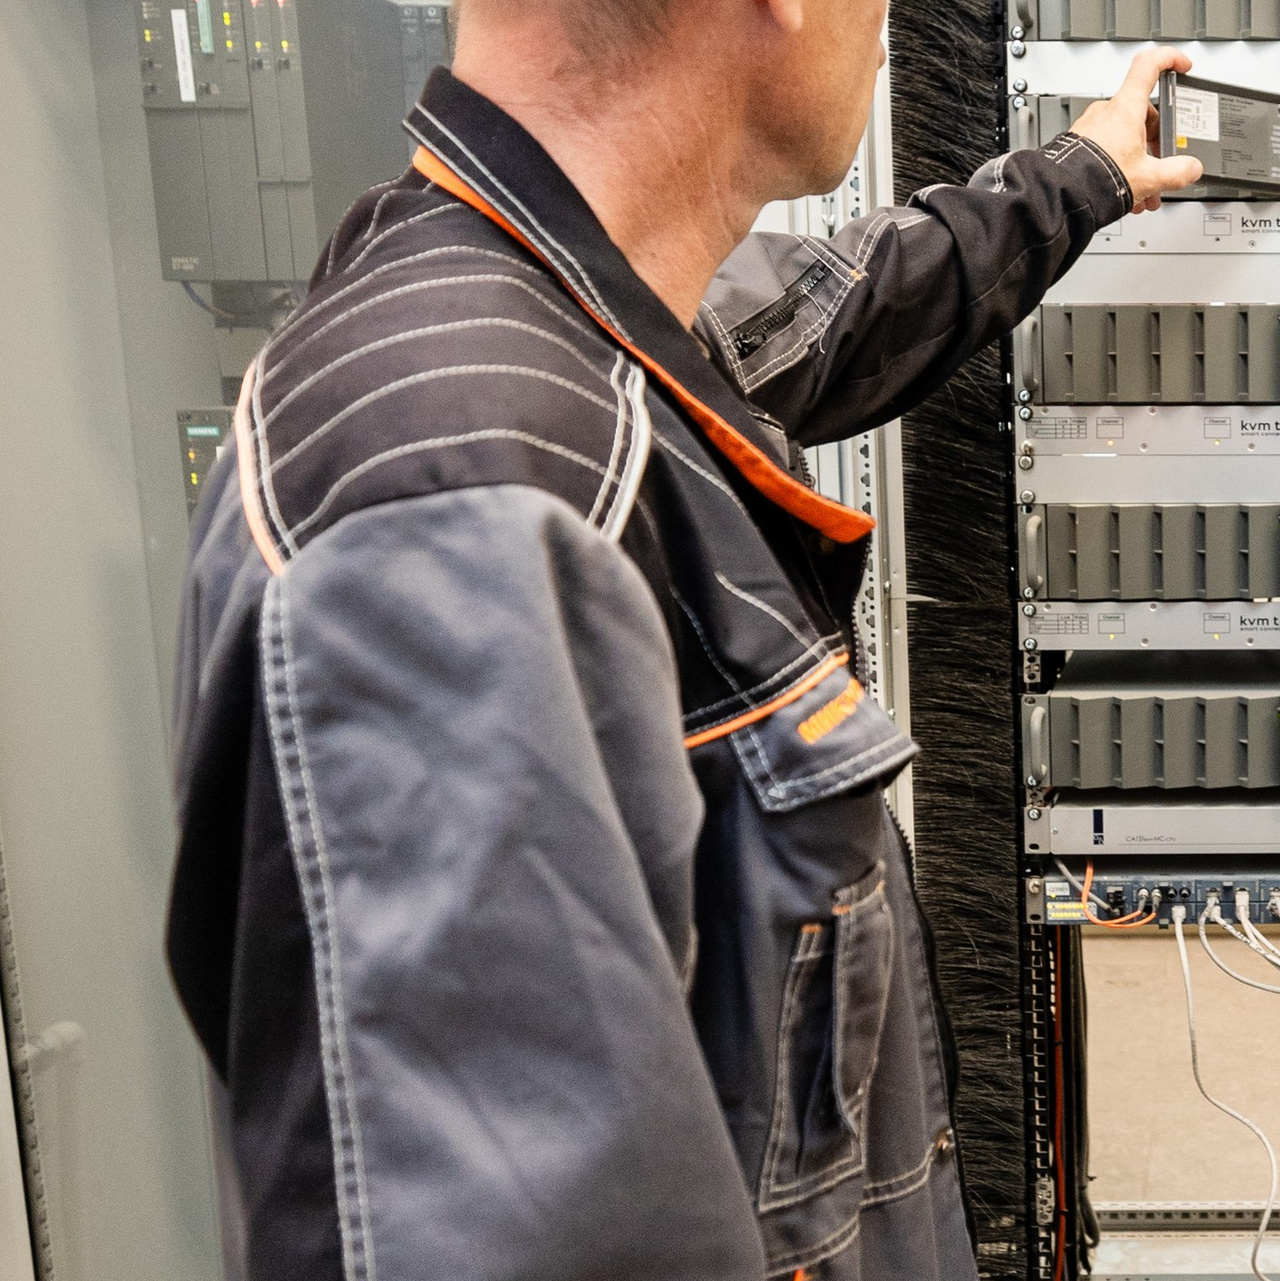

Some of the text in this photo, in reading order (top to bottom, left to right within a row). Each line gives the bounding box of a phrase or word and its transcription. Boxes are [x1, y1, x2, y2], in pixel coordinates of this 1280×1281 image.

[1241, 216, 1272, 228] kvm
[1240, 420, 1271, 431] kvm
[1239, 615, 1270, 626] kvm
